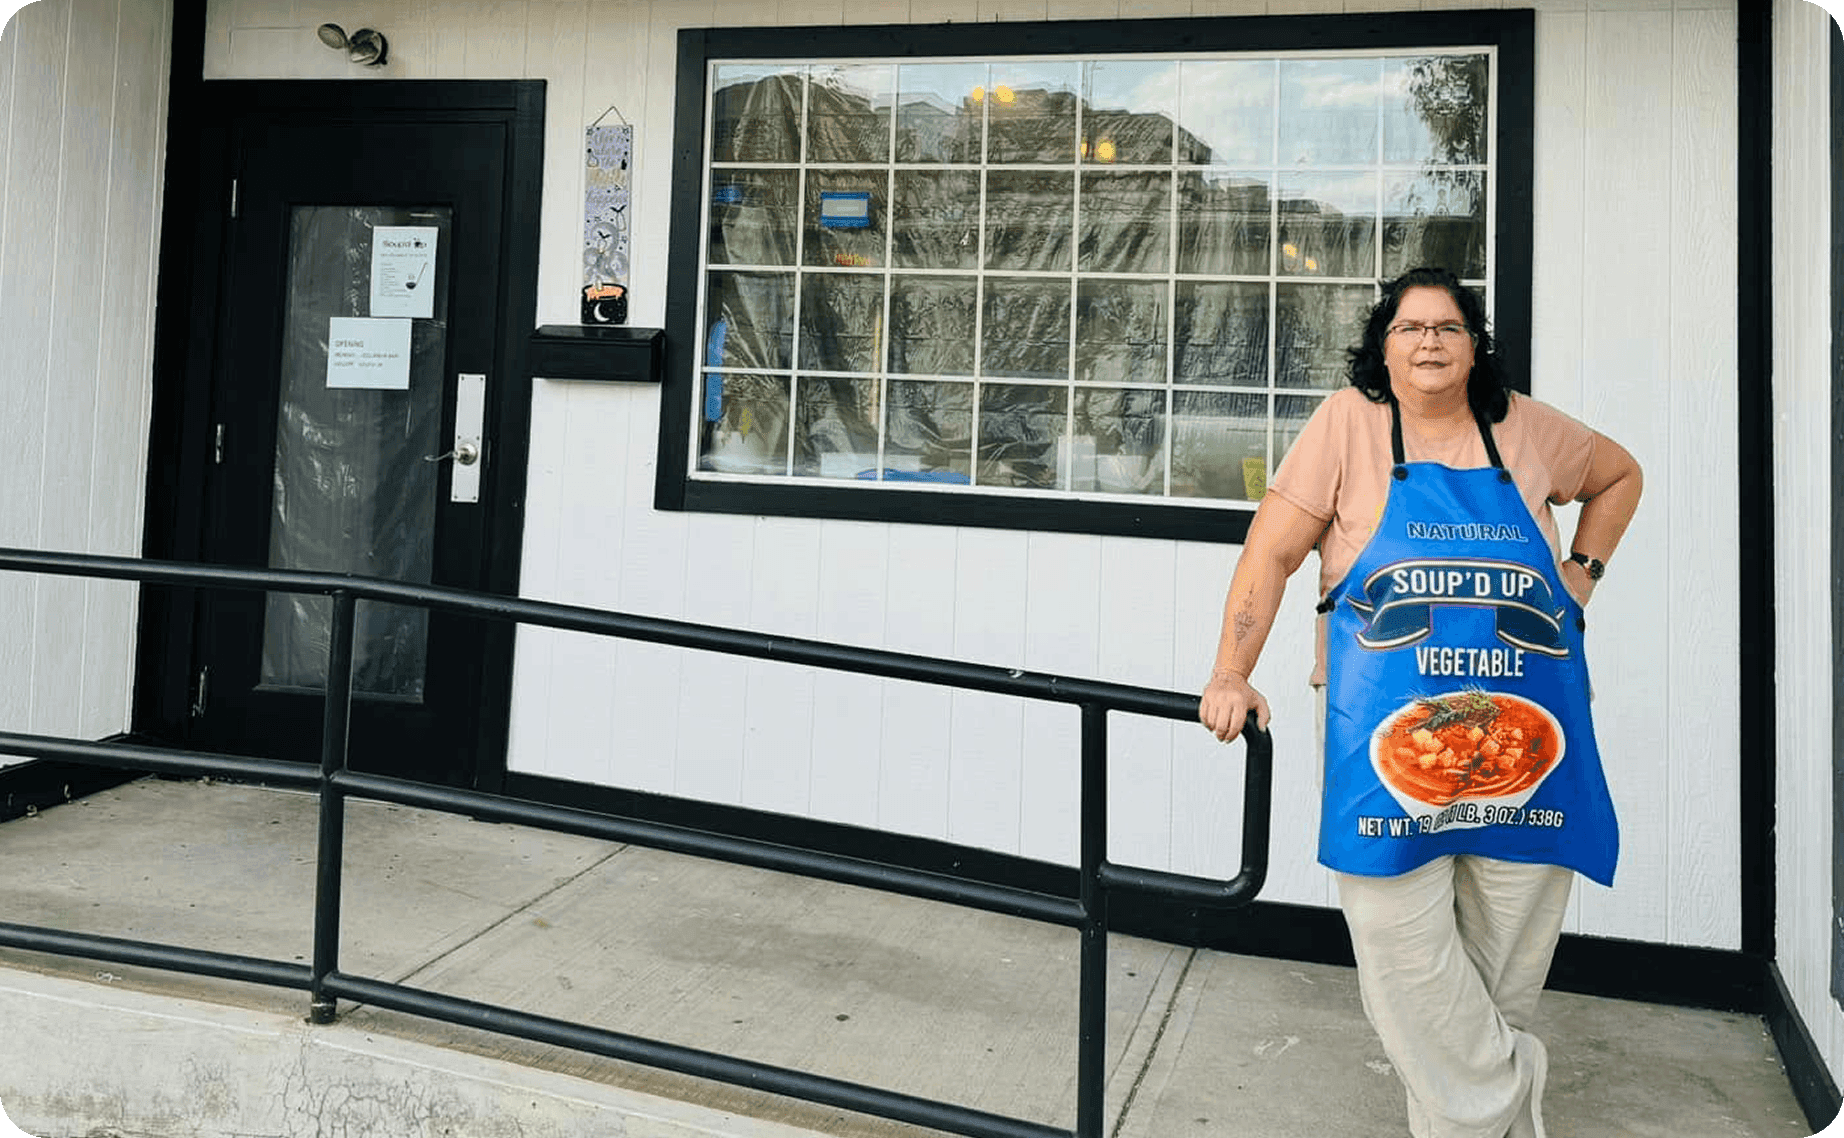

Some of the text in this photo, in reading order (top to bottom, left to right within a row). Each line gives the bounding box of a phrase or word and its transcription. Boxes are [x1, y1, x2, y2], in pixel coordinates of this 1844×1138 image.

[1406, 521, 1529, 544] NATURAL
[1391, 568, 1534, 598] SOUP'D UP
[1415, 647, 1525, 677] VEGETABLE
[1357, 816, 1384, 837] NET
[1388, 818, 1413, 838] WT.
[1417, 815, 1433, 834] 19
[1528, 808, 1564, 828] 538G
